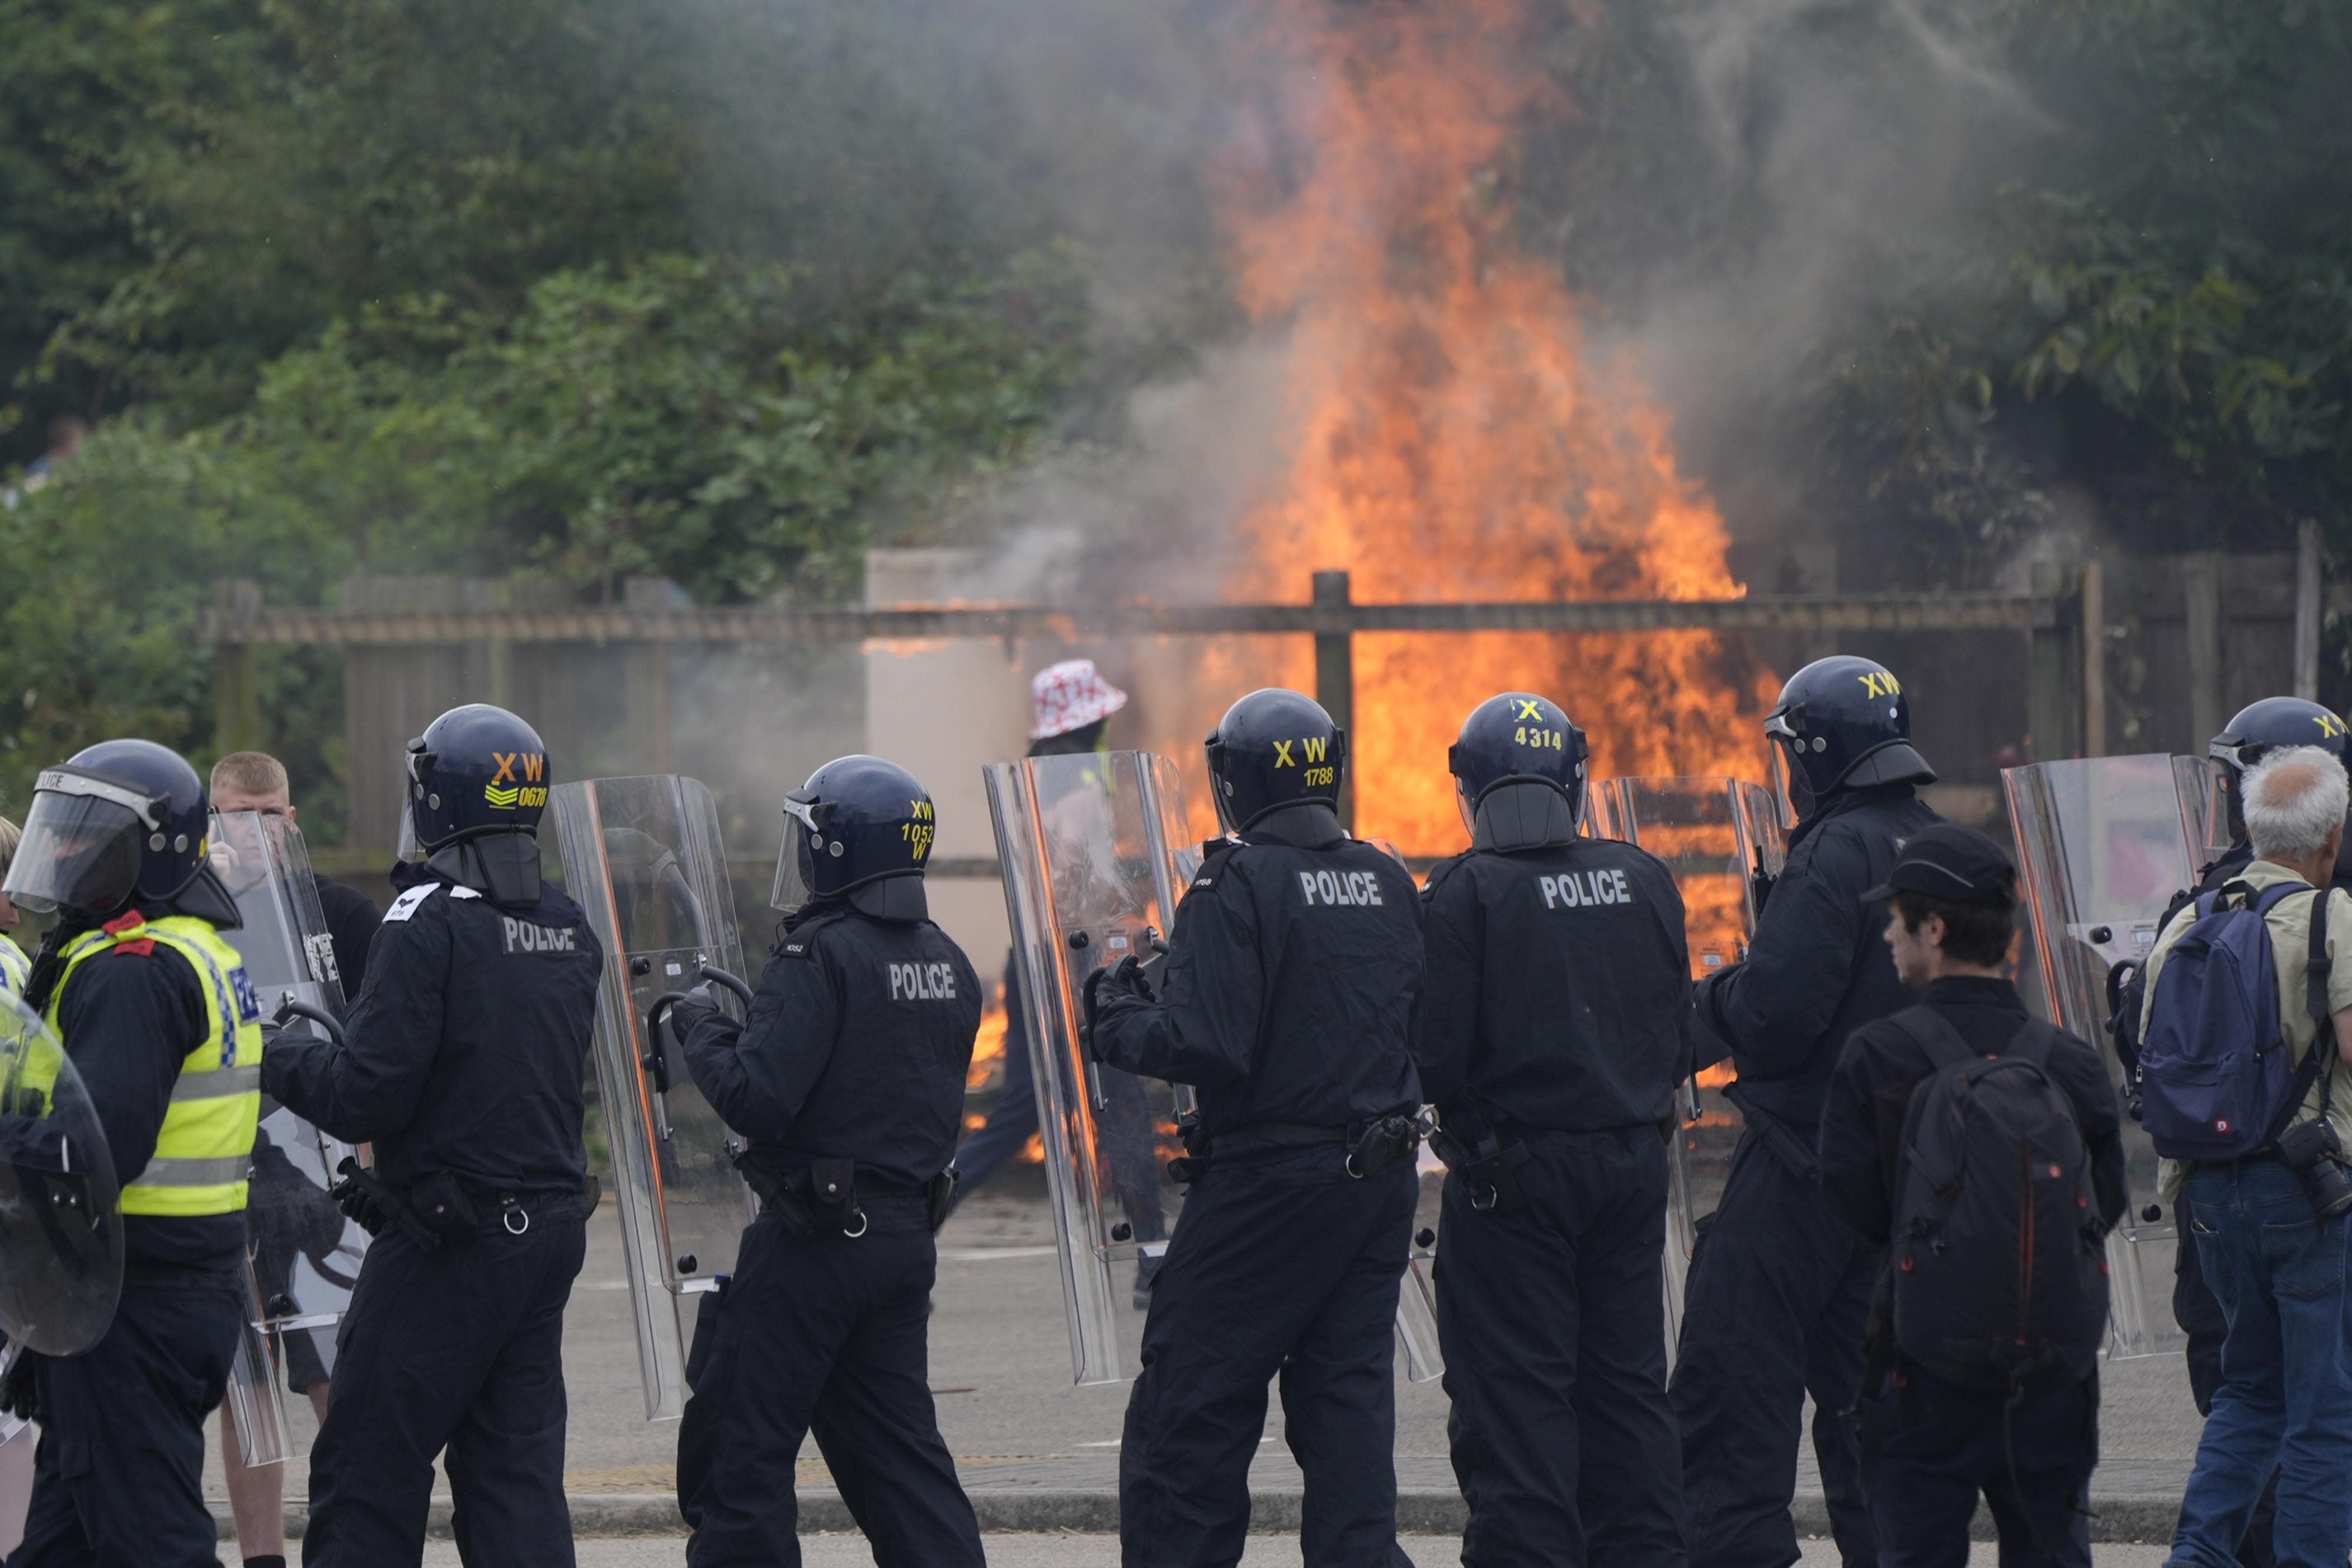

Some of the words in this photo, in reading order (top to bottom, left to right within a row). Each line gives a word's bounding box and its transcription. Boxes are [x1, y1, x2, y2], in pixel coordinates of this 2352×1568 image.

[1857, 672, 1900, 700] XW
[1517, 700, 1543, 723] X
[1515, 727, 1562, 751] 4314
[1304, 767, 1334, 787] 1788
[518, 787, 547, 807] 0678
[910, 800, 933, 821] XW
[902, 823, 934, 843] 1052
[913, 842, 927, 860] W
[1299, 870, 1383, 906] POLICE
[1539, 870, 1632, 910] POLICE
[503, 917, 575, 952] POLICE
[787, 944, 803, 952] 1052
[889, 963, 956, 1000] POLICE
